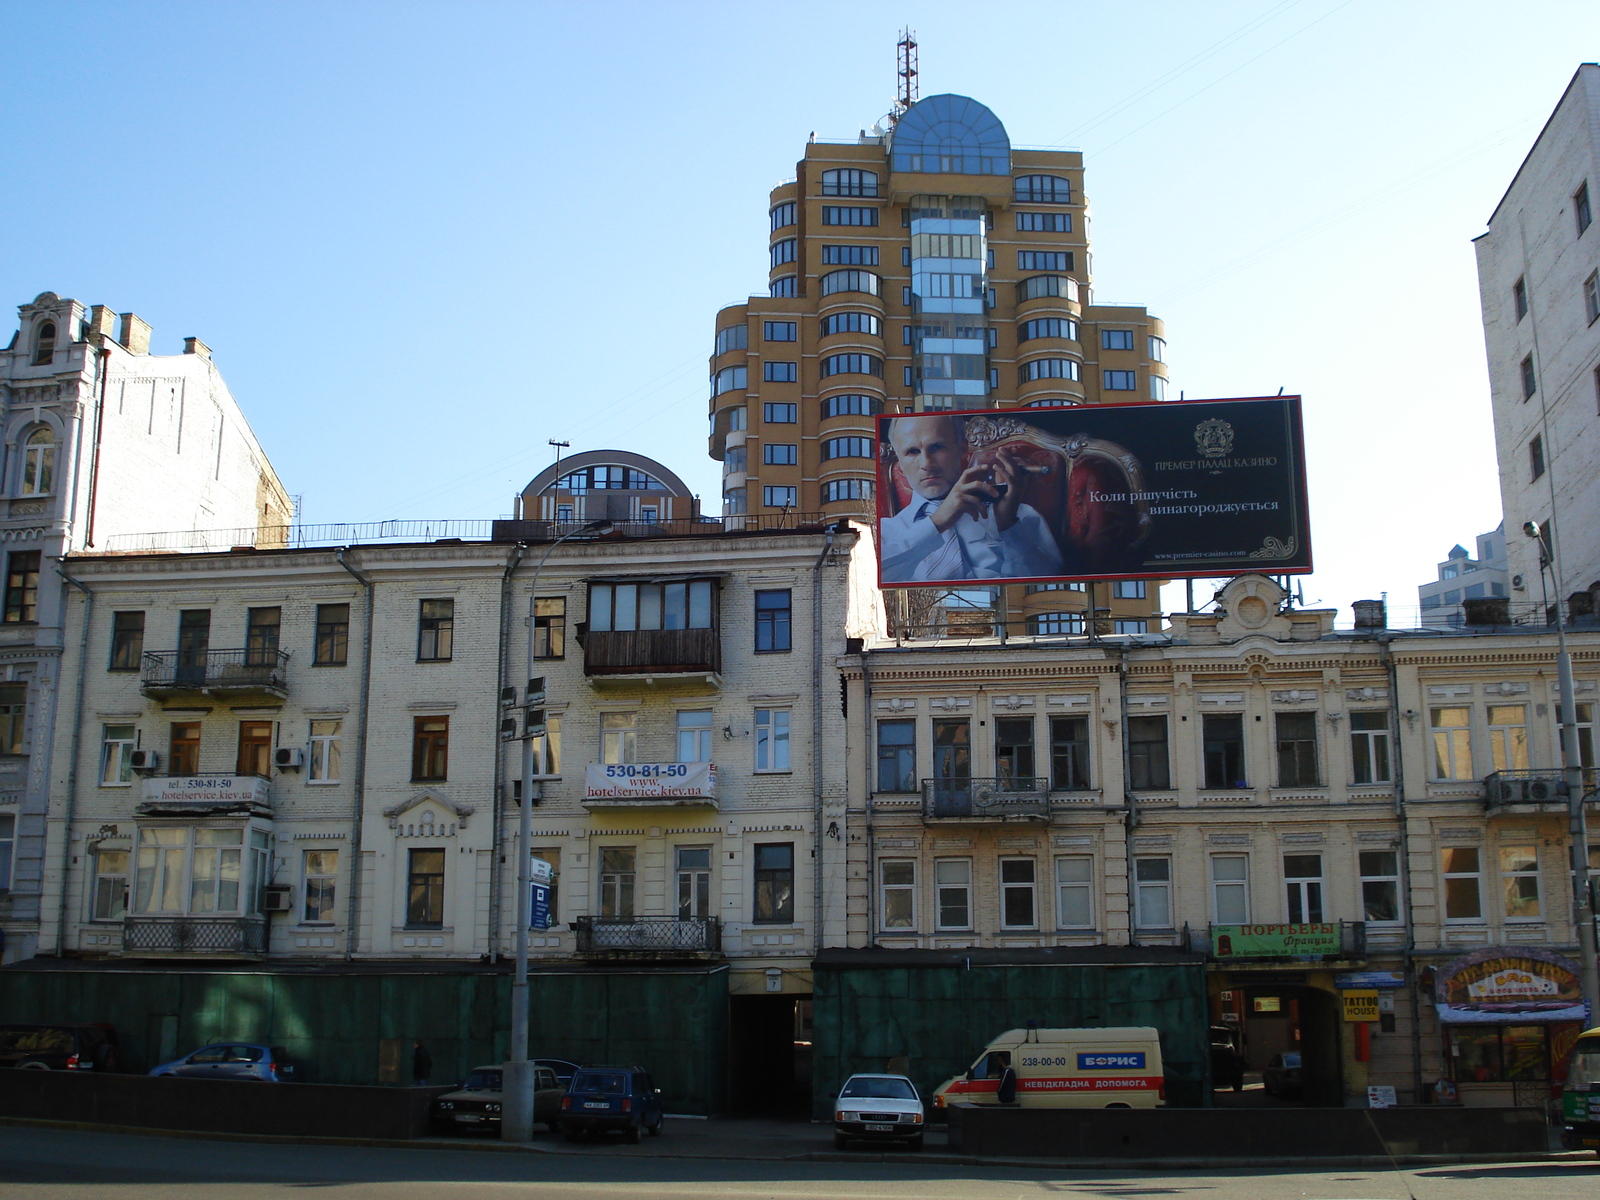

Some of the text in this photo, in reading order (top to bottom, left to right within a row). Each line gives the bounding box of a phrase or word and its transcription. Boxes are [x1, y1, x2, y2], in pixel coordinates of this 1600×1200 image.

[1198, 459, 1232, 470] ПАЛАЦ
[1234, 456, 1278, 467] КАЗИНО
[1089, 488, 1197, 504] Коли рішучість
[1149, 501, 1279, 516] винагороджується
[1154, 549, 1246, 561] www.premier-casino.com
[606, 765, 687, 777] 530-81-50
[188, 779, 231, 788] 530-81-50
[161, 791, 252, 800] hotelservice.kiev.ua
[587, 785, 701, 797] hotelservice.kiev.ua
[1241, 923, 1335, 936] ПОРТЬЕРЫ
[1283, 935, 1335, 947] Франция
[1344, 997, 1378, 1006] TATTOO
[1346, 1007, 1377, 1015] HOUSE
[1022, 1057, 1066, 1066] 238-00-00
[1085, 1056, 1138, 1066] БОРИС
[1024, 1080, 1148, 1089] НЕВІДКЛАДНА ДОПОМОГА
